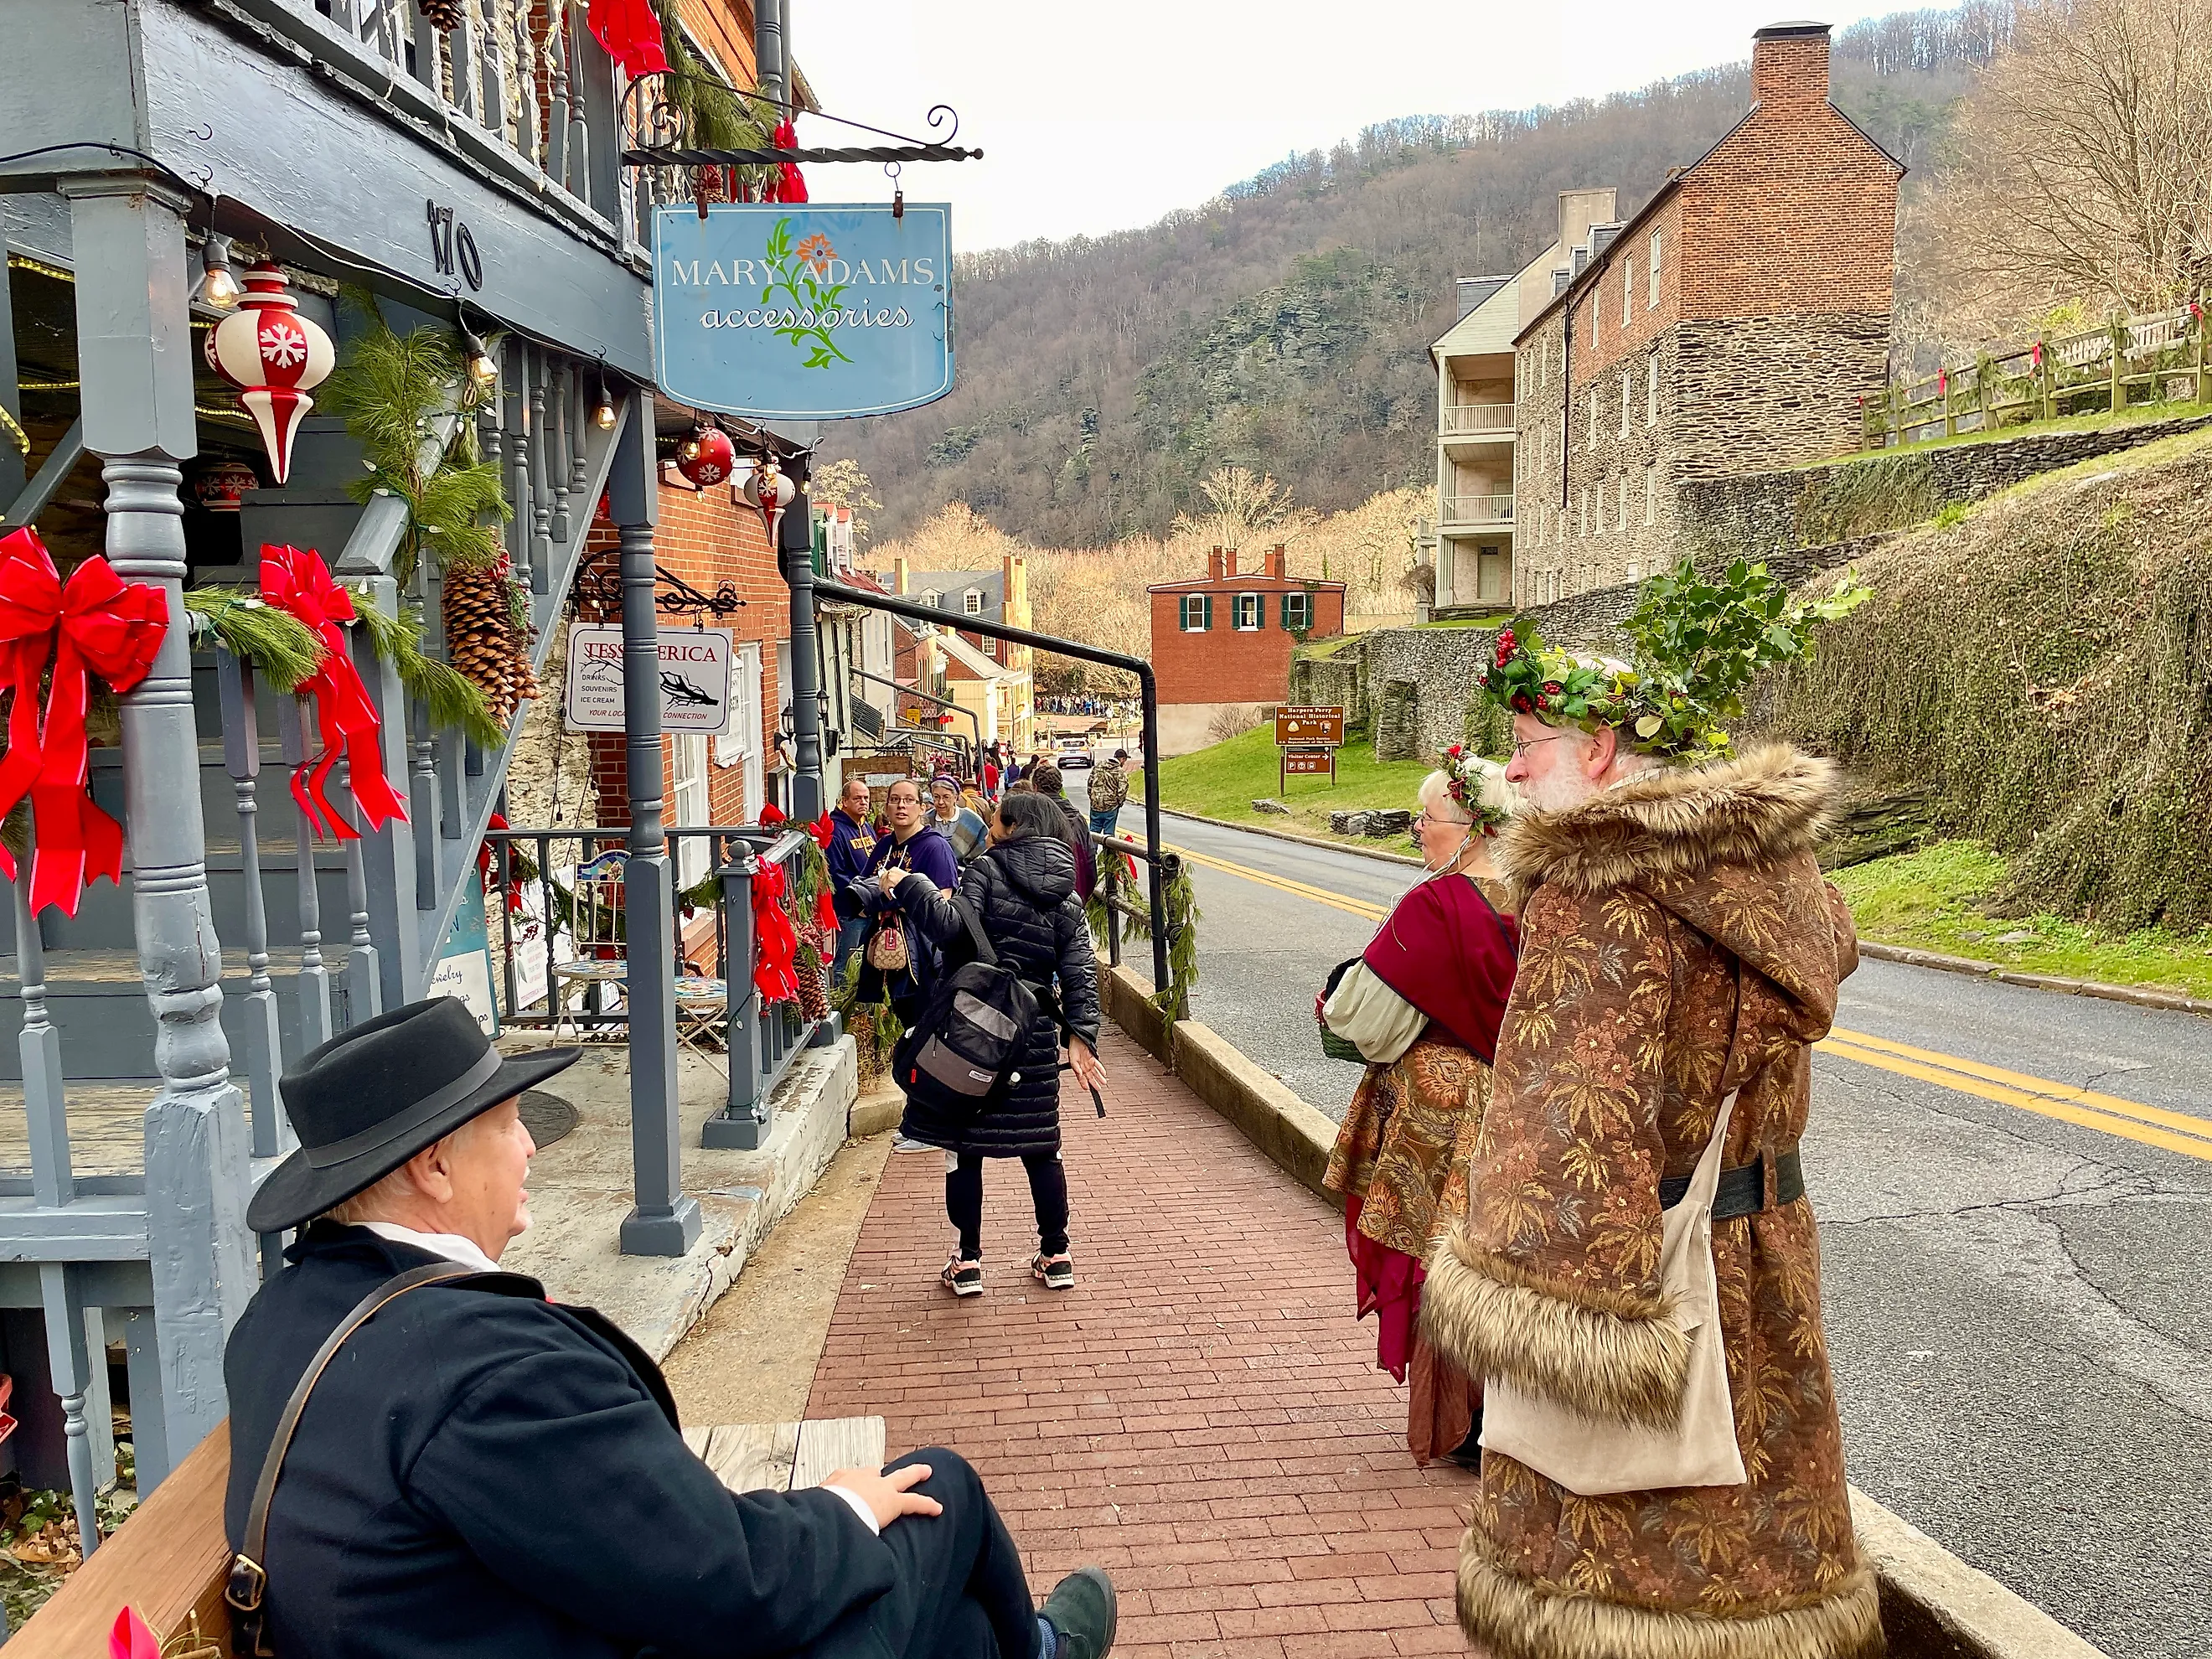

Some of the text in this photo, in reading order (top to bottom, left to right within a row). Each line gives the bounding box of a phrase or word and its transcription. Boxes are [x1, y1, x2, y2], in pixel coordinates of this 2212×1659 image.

[426, 198, 483, 292] 170
[671, 258, 935, 287] MARY ADAMS
[699, 297, 915, 329] accessories
[581, 674, 606, 682] DRINKS
[663, 711, 708, 720] CONNECTION
[431, 964, 463, 985] ewelry
